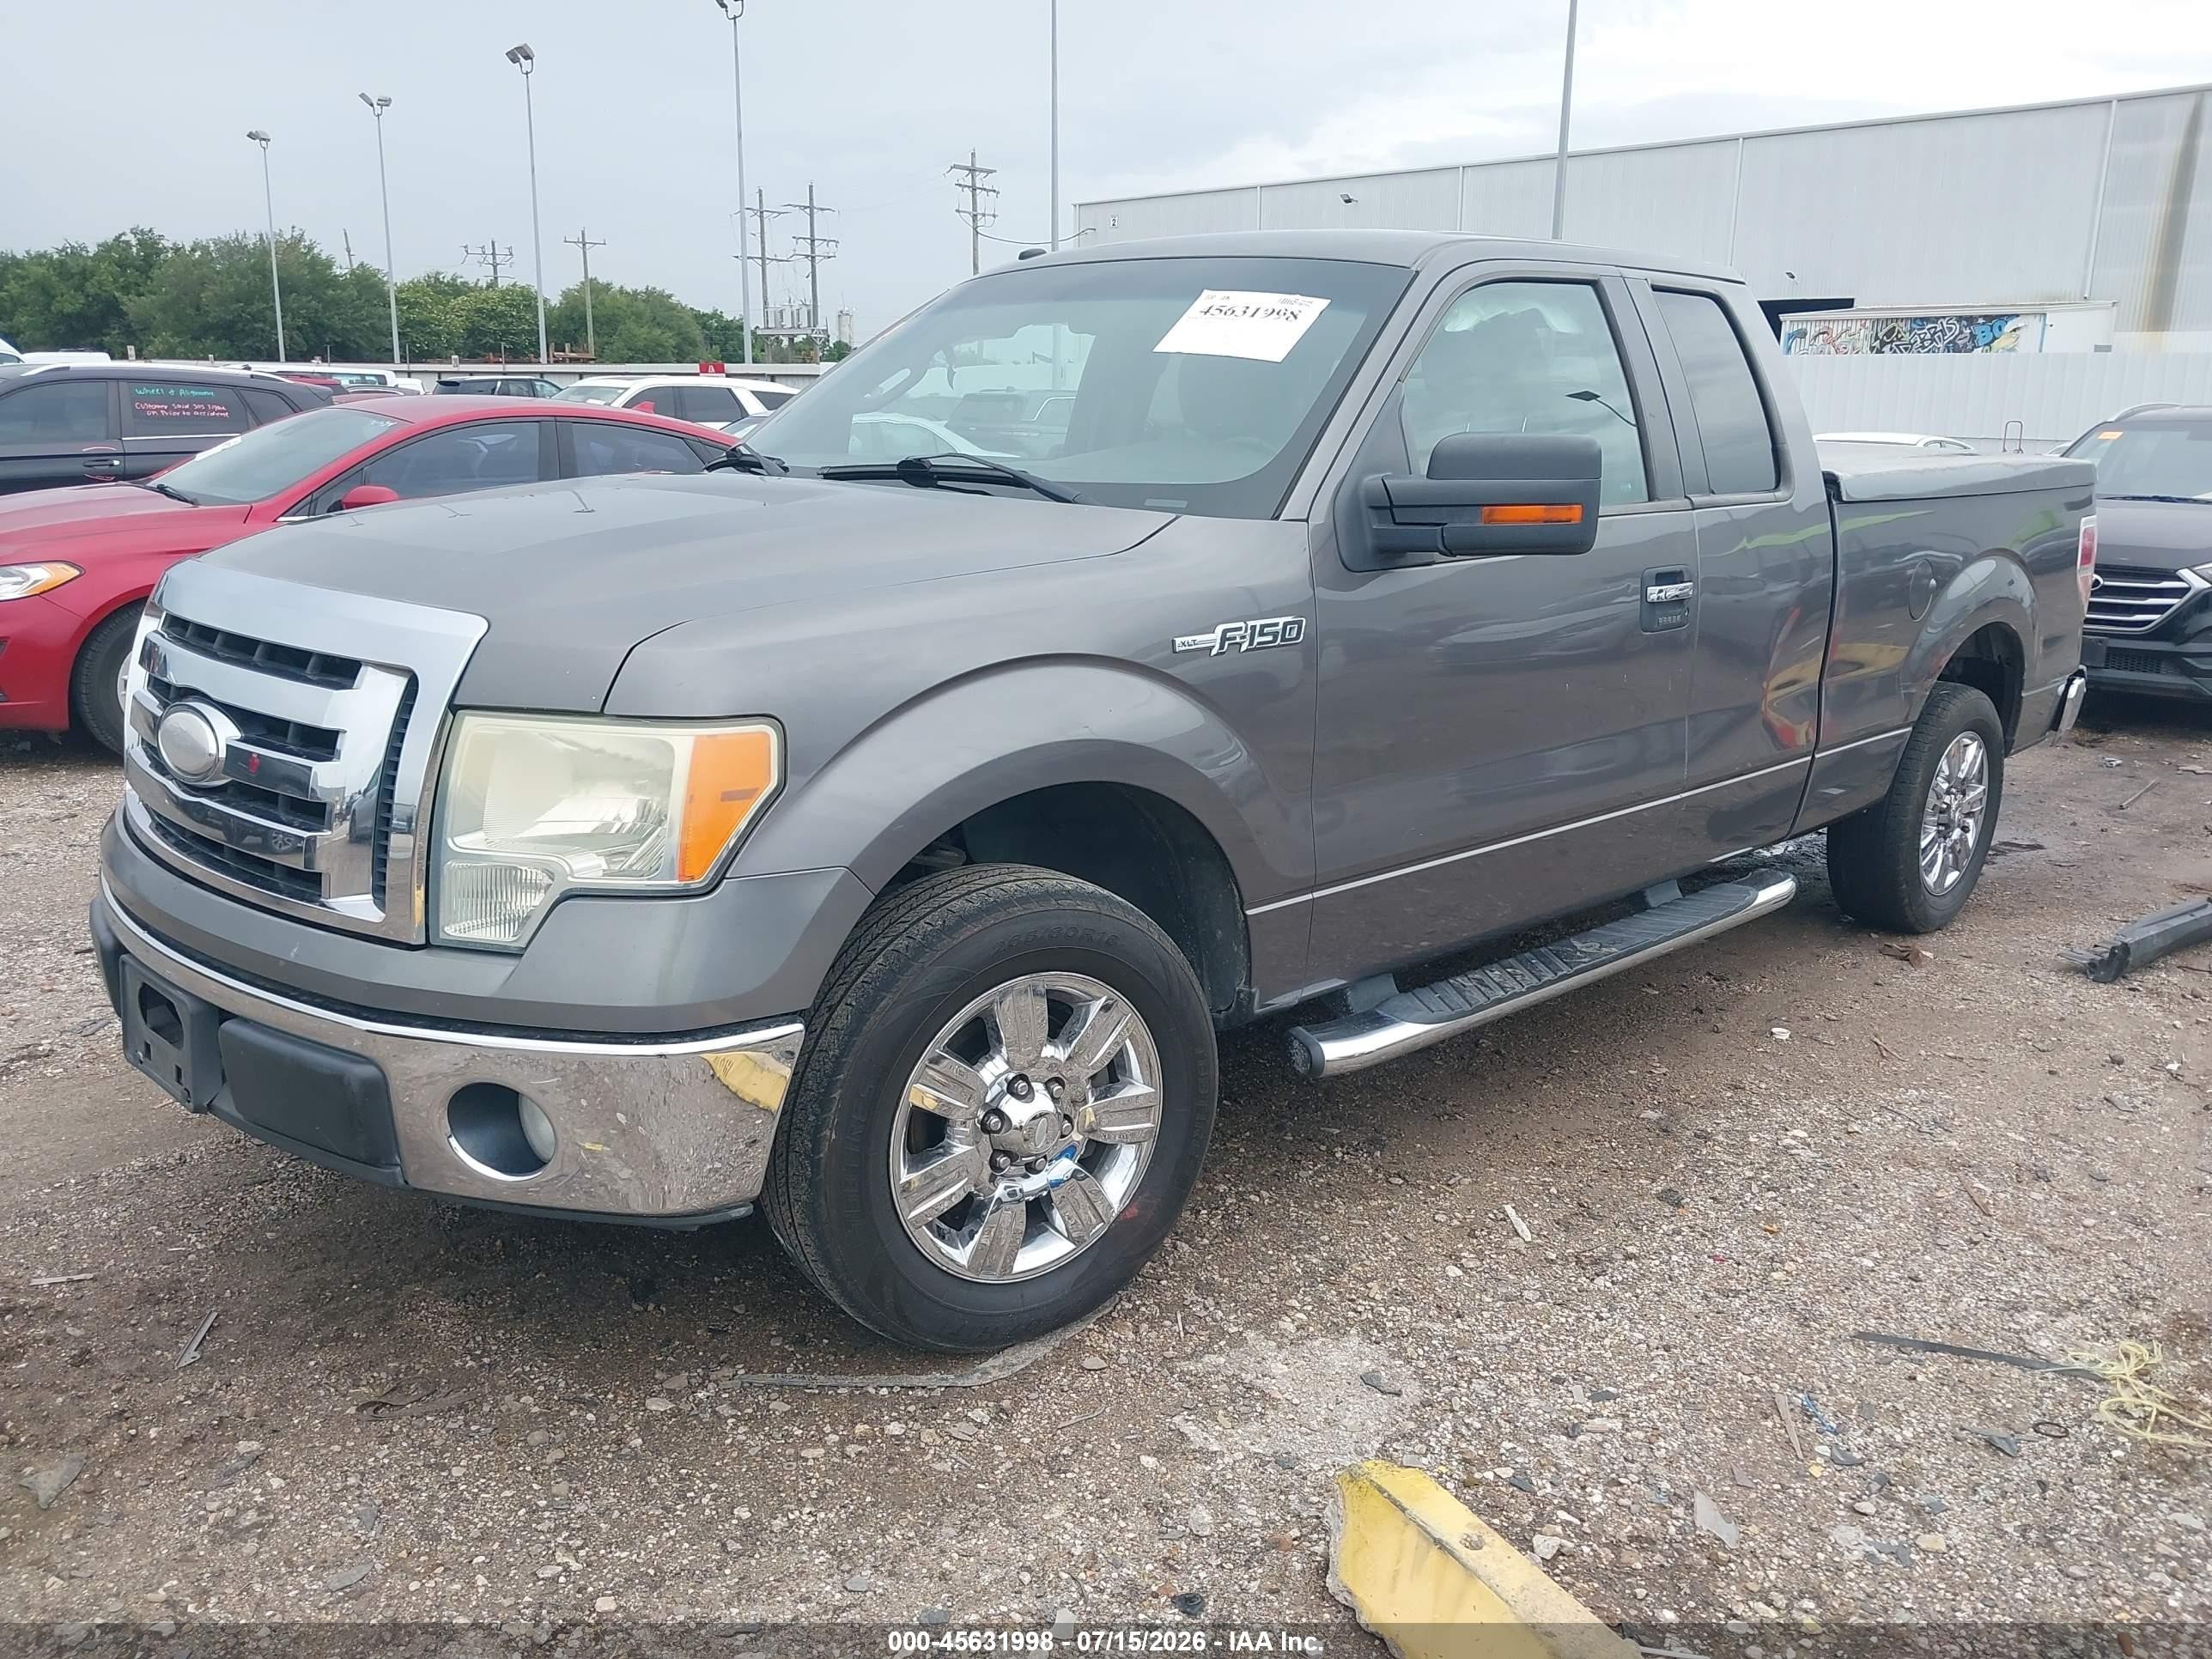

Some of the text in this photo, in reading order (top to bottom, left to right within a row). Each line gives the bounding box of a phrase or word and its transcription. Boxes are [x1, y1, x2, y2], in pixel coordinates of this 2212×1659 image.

[1199, 304, 1302, 322] 45631998
[1179, 617, 1305, 655] XLT F-150
